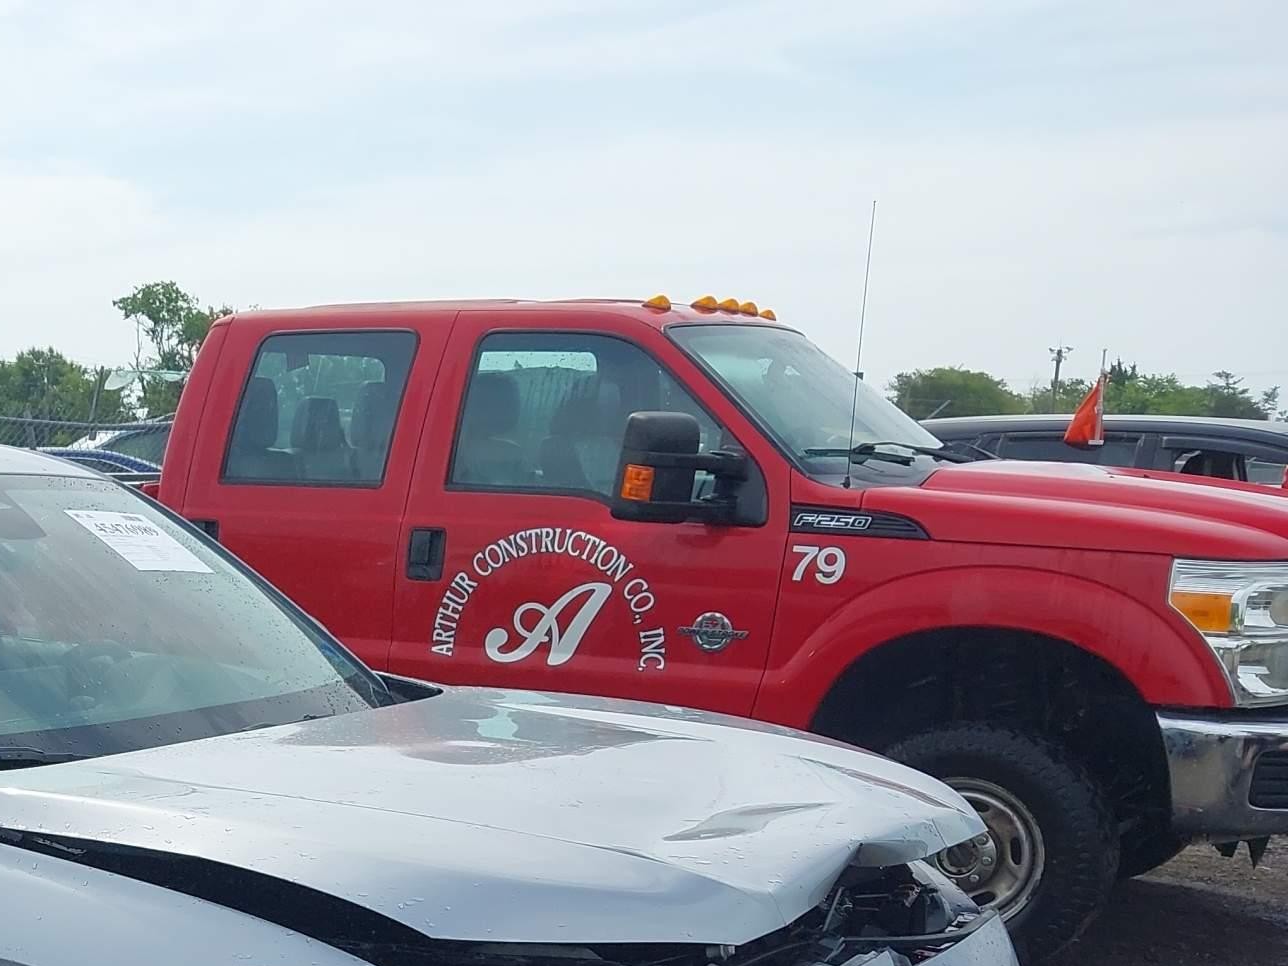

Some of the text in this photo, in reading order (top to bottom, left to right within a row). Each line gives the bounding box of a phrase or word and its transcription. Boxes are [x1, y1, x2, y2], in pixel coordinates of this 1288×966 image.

[431, 571, 479, 657] ARTHUR
[472, 527, 634, 582] CONSTRUCTION
[638, 627, 666, 672] INC.
[792, 545, 847, 585] 79
[484, 582, 613, 667] A
